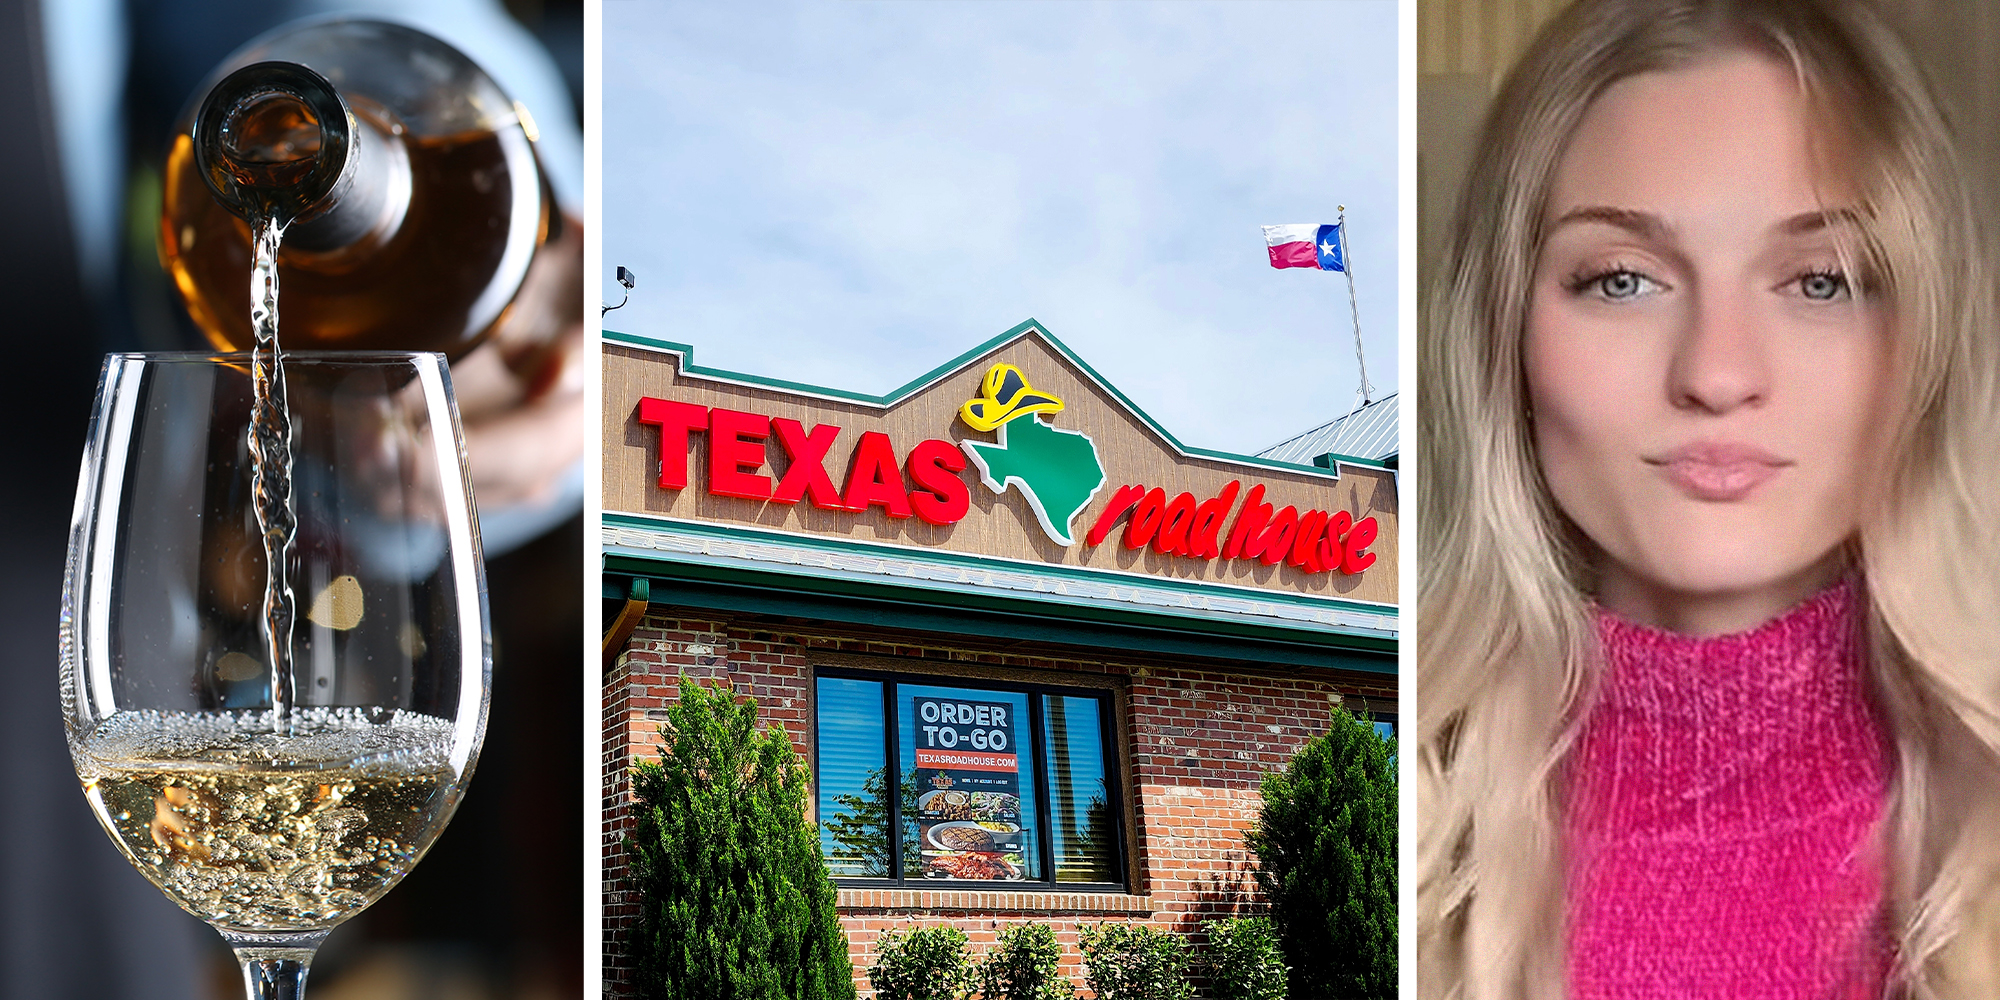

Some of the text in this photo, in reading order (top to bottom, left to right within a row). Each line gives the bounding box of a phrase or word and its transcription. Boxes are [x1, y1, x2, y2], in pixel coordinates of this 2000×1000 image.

[638, 397, 971, 527] TEXAS
[921, 701, 1007, 727] ORDER
[923, 725, 1007, 750] TO-GO
[919, 754, 1015, 767] TEXASROADHOUSE.COM
